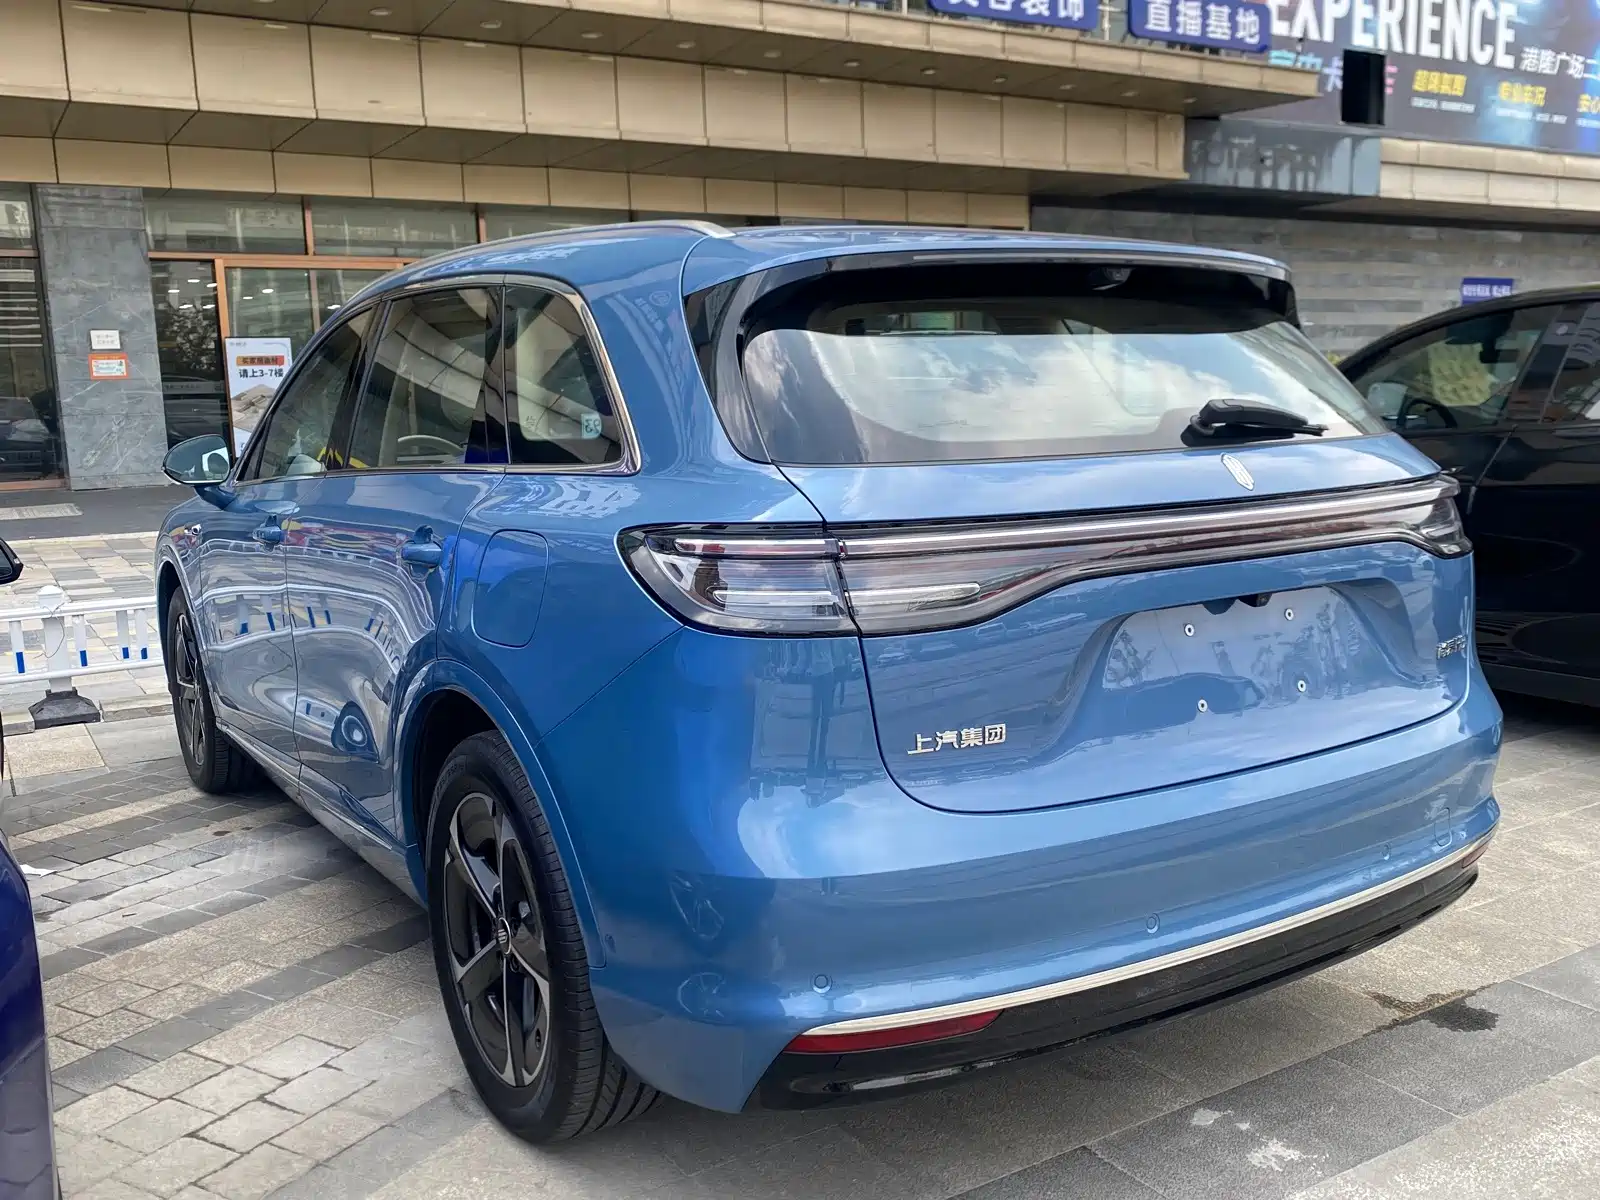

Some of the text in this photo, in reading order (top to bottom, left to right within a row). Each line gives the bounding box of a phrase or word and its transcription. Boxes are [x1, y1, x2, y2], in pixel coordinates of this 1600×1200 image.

[1145, 0, 1260, 44] 直播基地
[1268, 0, 1517, 69] EXPERIENCE
[239, 368, 284, 379] 请上3-7楼
[907, 723, 1006, 755] 上汽集团
